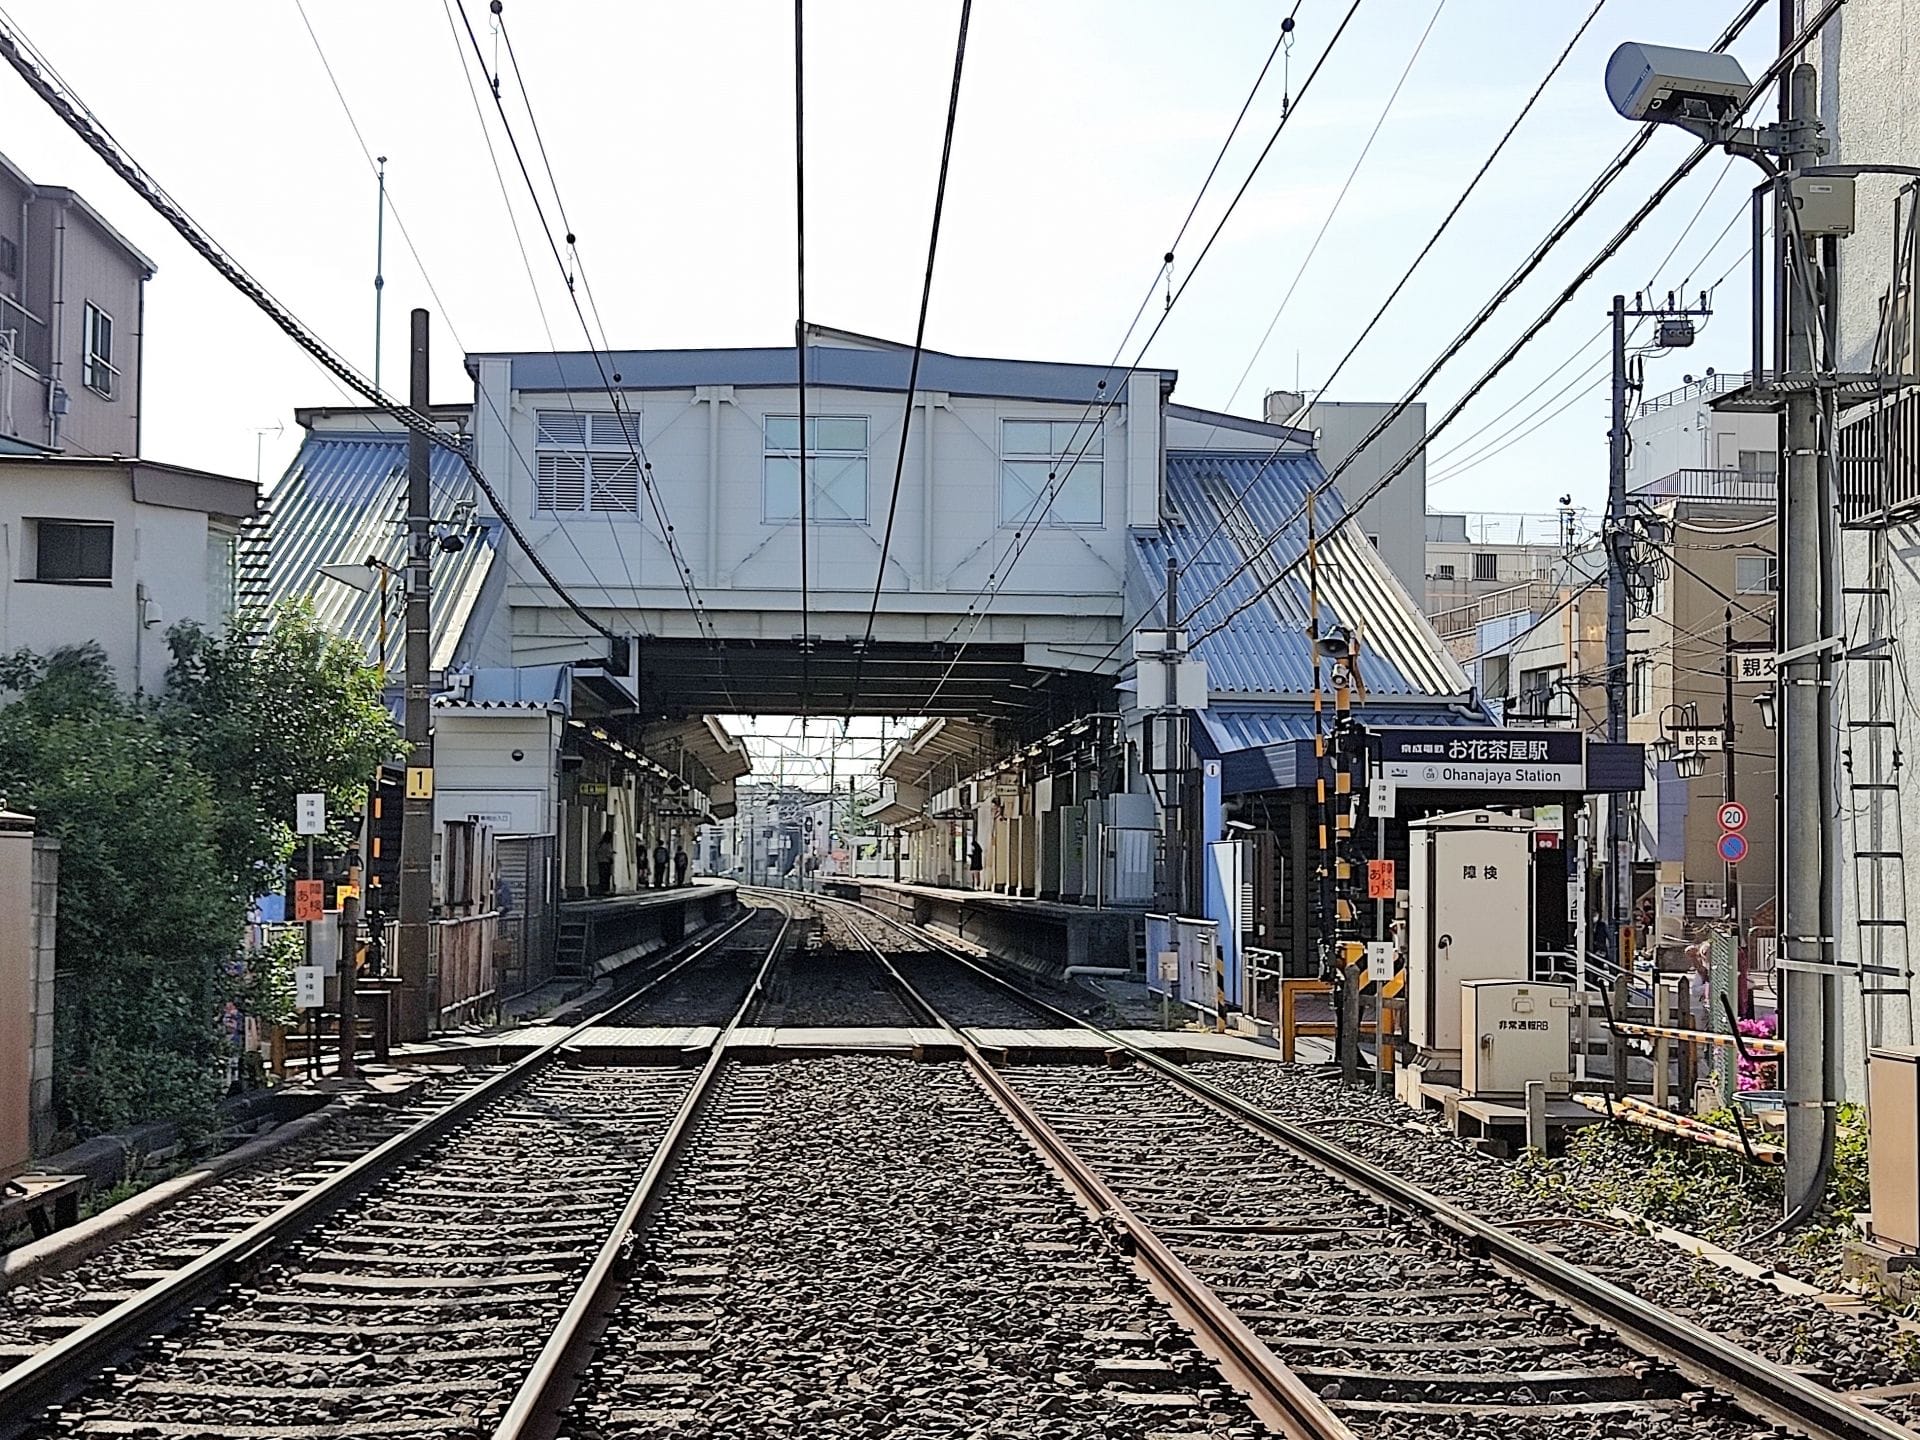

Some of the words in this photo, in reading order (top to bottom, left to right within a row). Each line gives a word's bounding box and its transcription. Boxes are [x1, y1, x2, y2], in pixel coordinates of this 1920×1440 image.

[1685, 735, 1718, 746] 親交会
[1448, 739, 1548, 761] お花茶屋駅
[416, 770, 423, 790] 1
[1442, 768, 1511, 784] Ohanajaya
[1515, 768, 1561, 782] Station
[1724, 811, 1741, 824] 20
[1462, 865, 1498, 880] 障検
[1369, 869, 1381, 896] あり
[297, 890, 309, 918] あり
[1498, 1019, 1549, 1031] 非常通報RB
